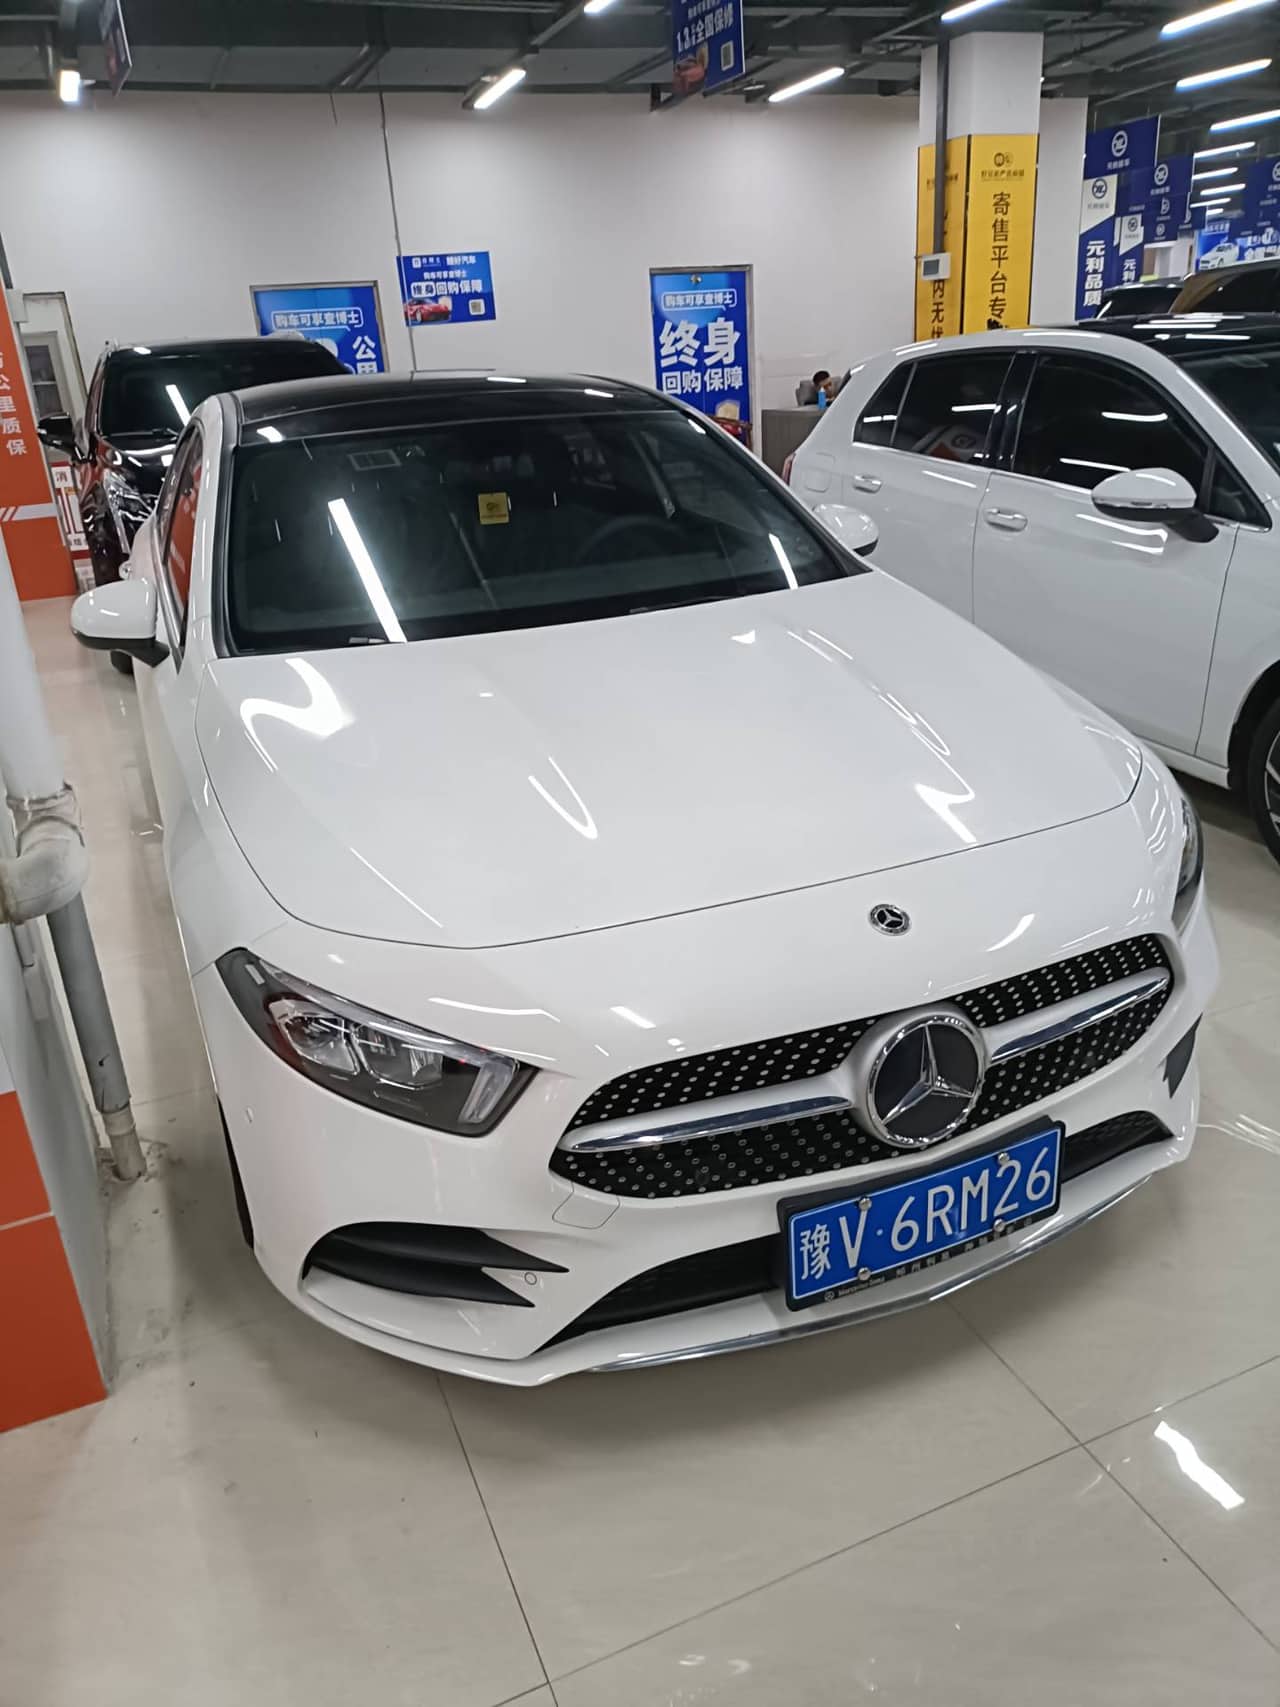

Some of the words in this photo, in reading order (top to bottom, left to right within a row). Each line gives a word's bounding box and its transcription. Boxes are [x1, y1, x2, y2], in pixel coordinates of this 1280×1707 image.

[988, 192, 1011, 319] 寄售平台专
[1083, 241, 1105, 306] 元利品质
[275, 311, 360, 327] 购车可享查博士
[665, 293, 733, 306] 购车可享查博士
[659, 317, 740, 367] 终身
[0, 352, 27, 456] 公里质保
[662, 366, 743, 395] 回购保障
[800, 1147, 1051, 1280] 豫V·6RM26
